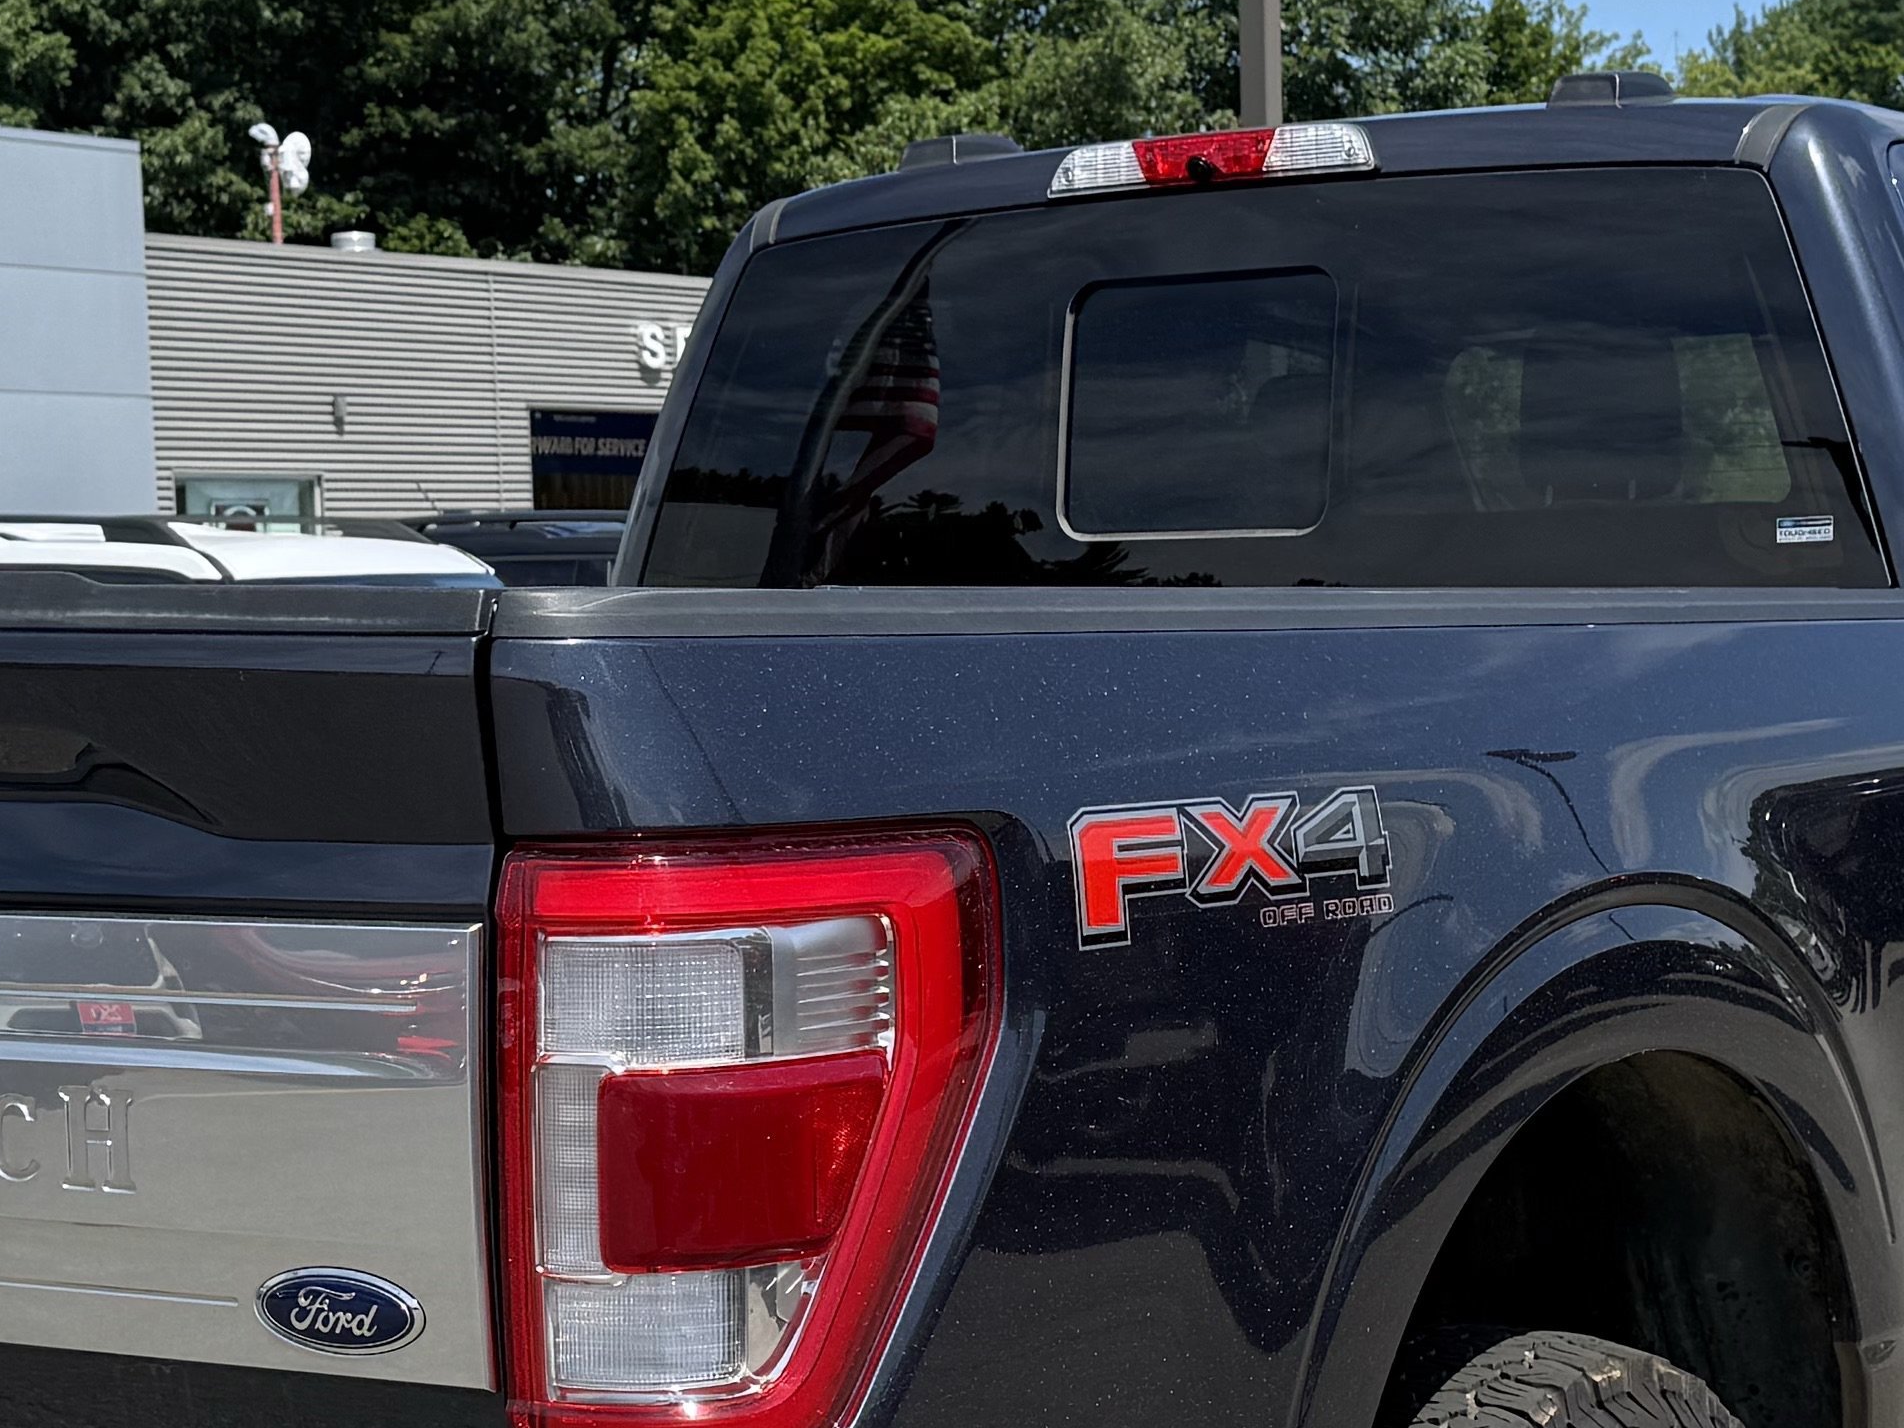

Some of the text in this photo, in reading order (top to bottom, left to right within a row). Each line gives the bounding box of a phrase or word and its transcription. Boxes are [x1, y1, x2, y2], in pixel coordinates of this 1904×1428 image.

[575, 436, 595, 456] FOR
[597, 437, 646, 458] SERVICE
[1067, 785, 1392, 951] FX4
[1260, 893, 1394, 928] OFF ROAD
[290, 1285, 379, 1338] Ford
